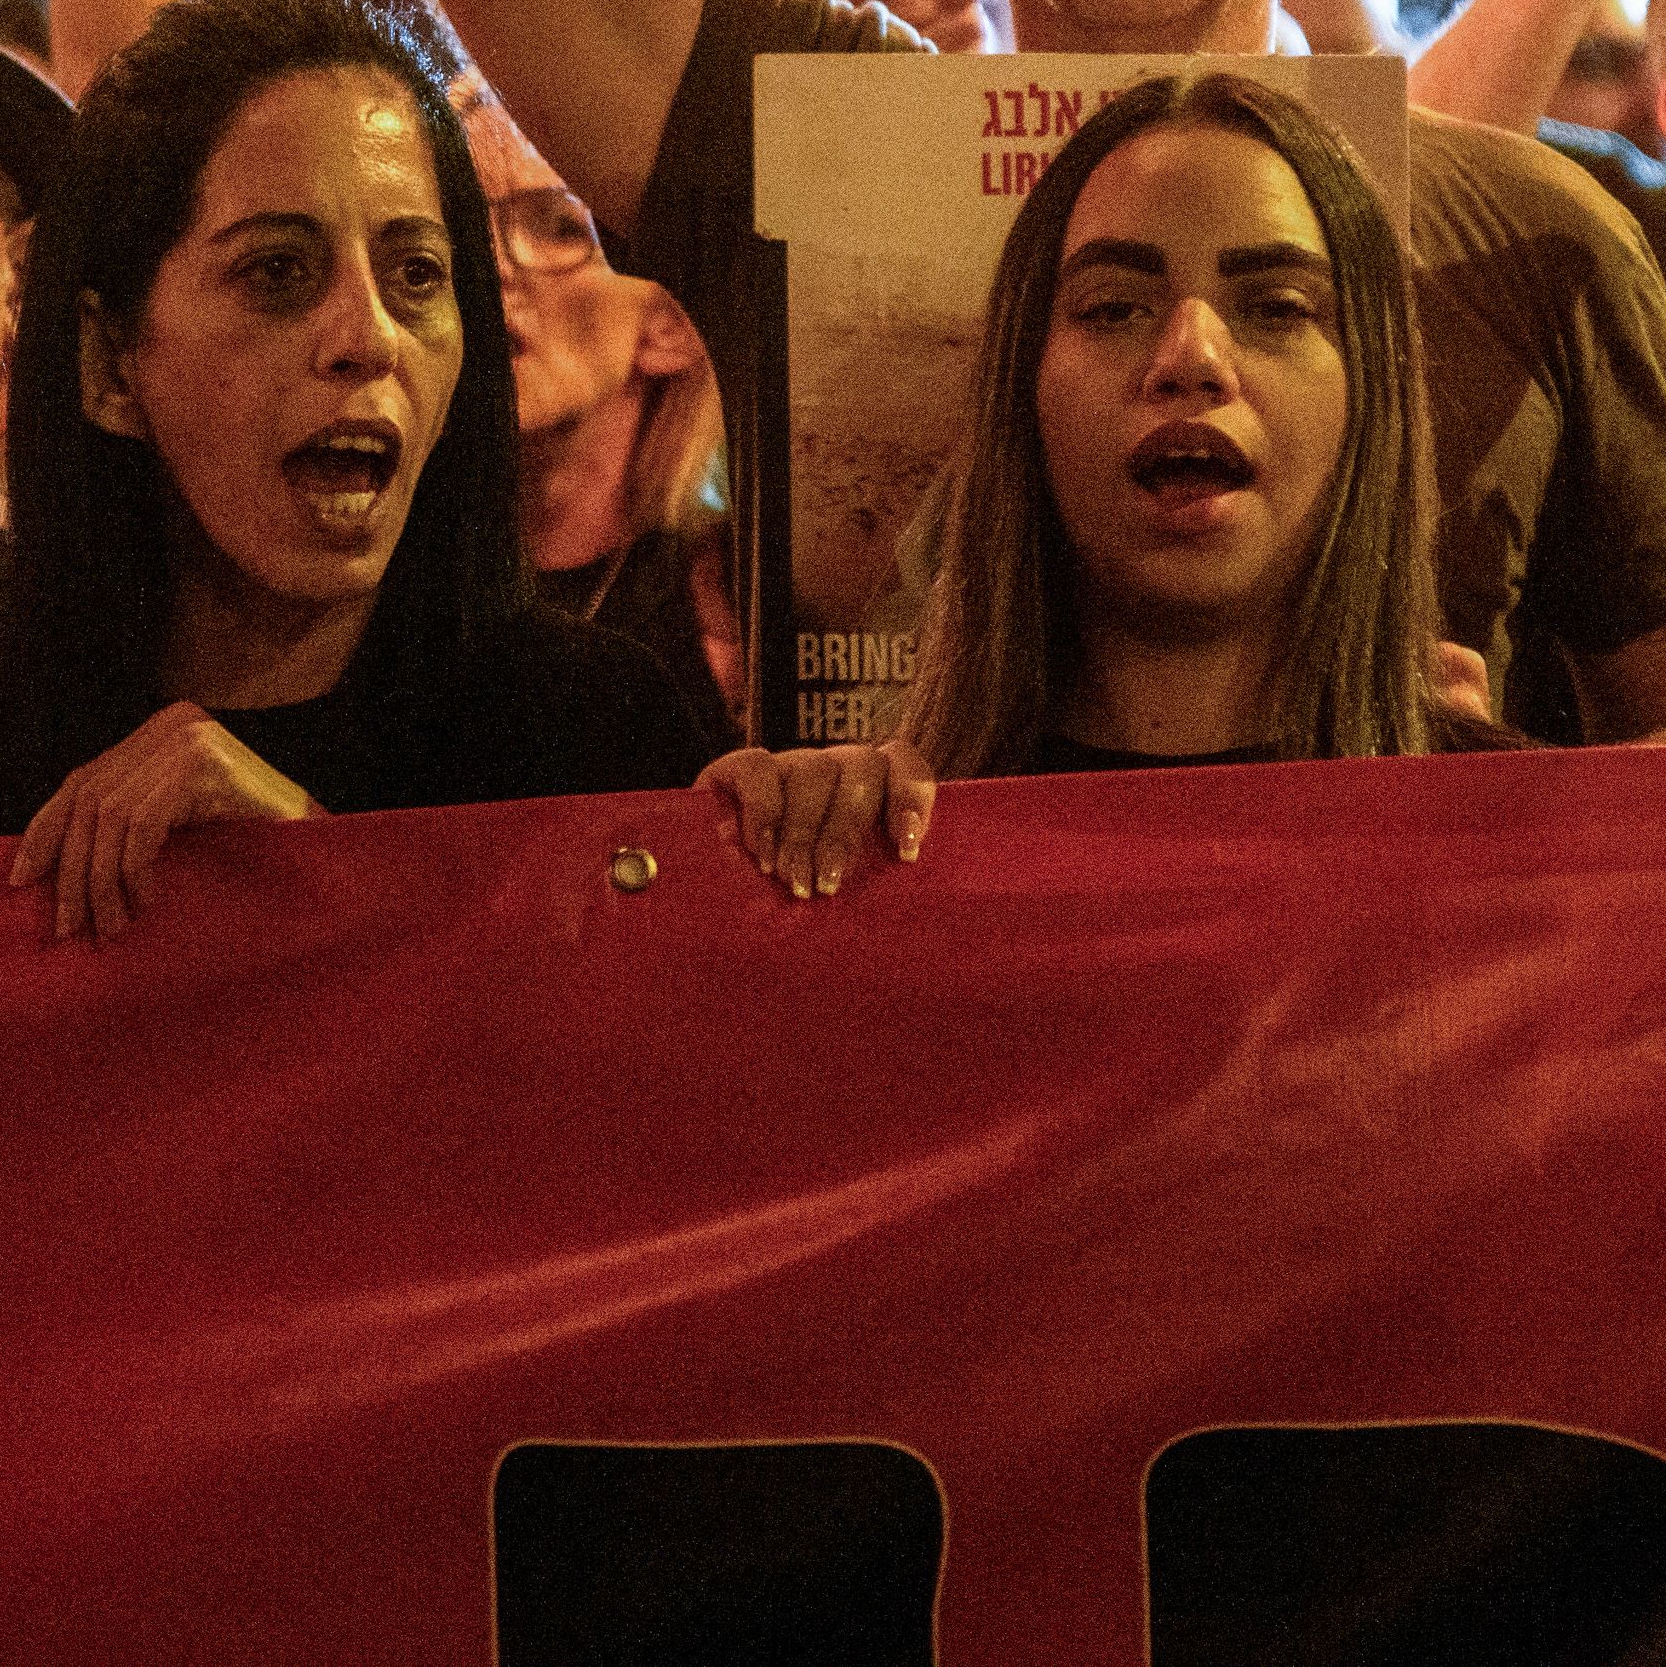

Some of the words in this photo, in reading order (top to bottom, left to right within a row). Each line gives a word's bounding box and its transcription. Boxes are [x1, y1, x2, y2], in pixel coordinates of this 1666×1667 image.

[982, 83, 1082, 137] אלבג
[796, 632, 917, 681] BRING
[797, 691, 873, 740] HER
